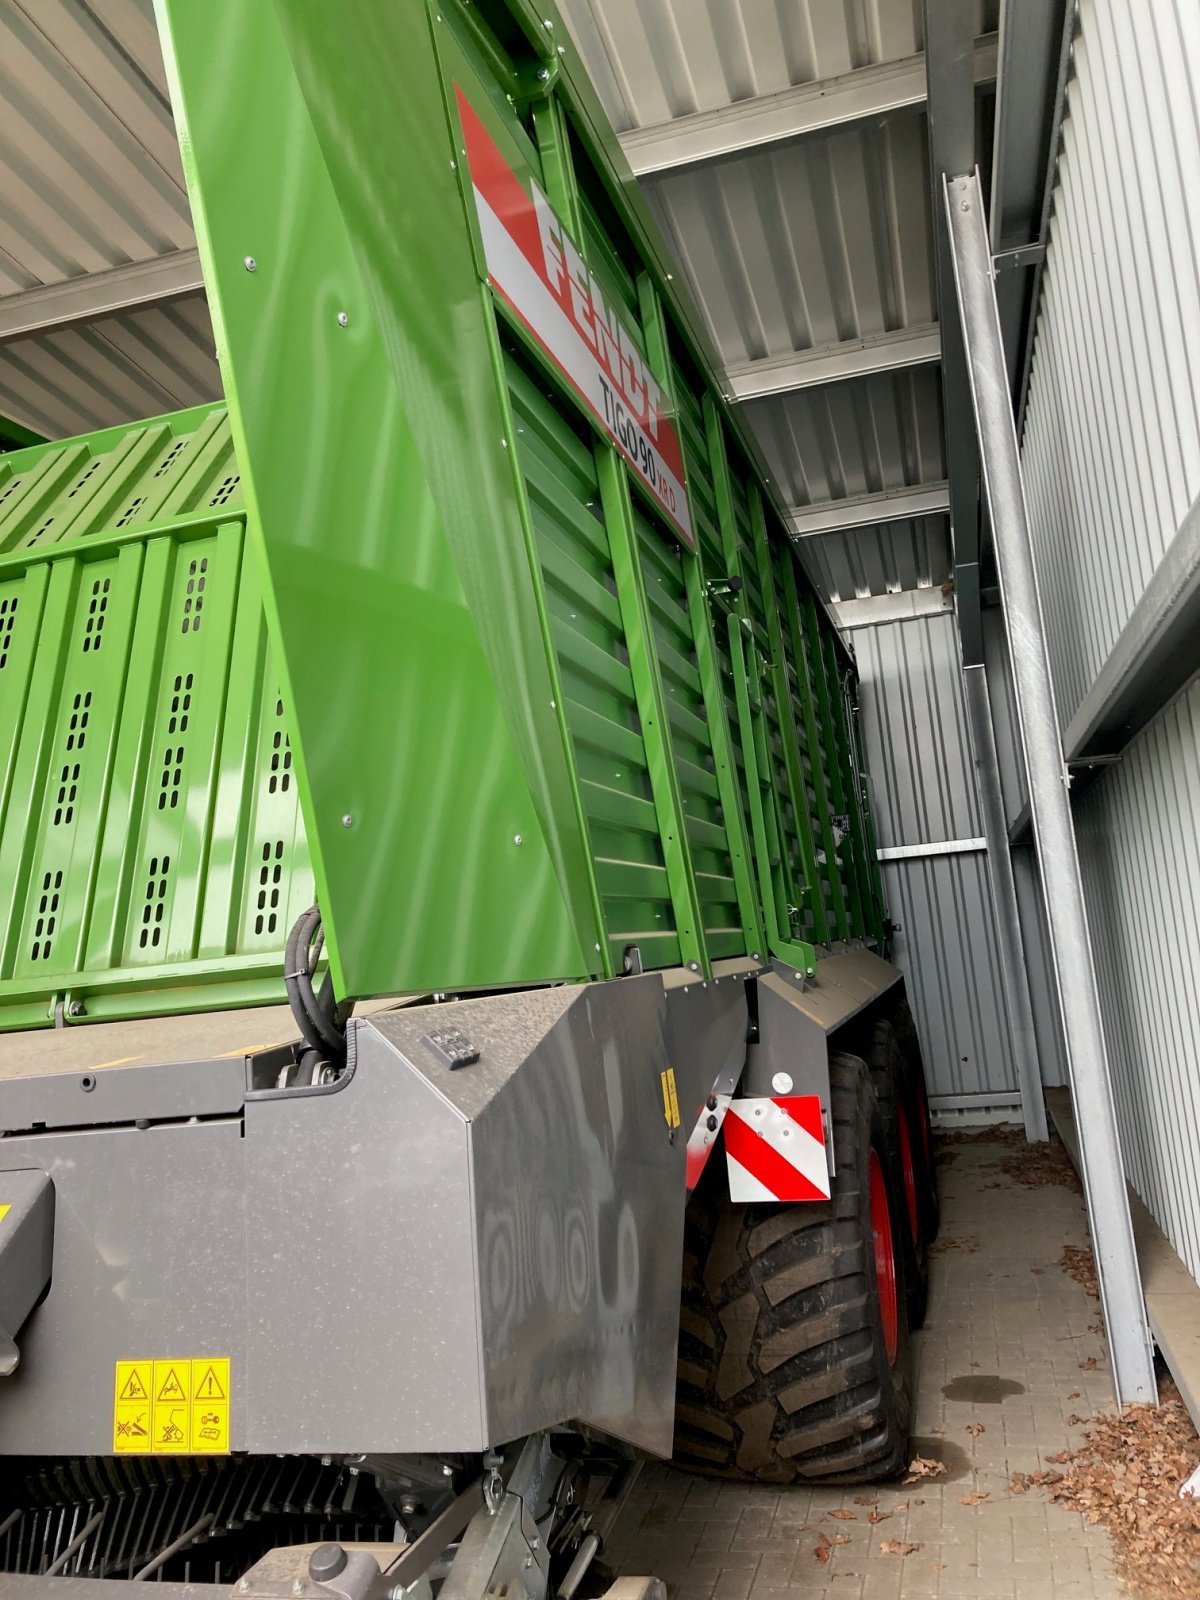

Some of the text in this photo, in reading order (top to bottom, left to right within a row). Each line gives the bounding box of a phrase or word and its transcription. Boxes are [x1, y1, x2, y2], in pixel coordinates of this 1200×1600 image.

[530, 176, 660, 442] FENDT
[598, 373, 638, 461] TIGO
[639, 436, 656, 486] 90
